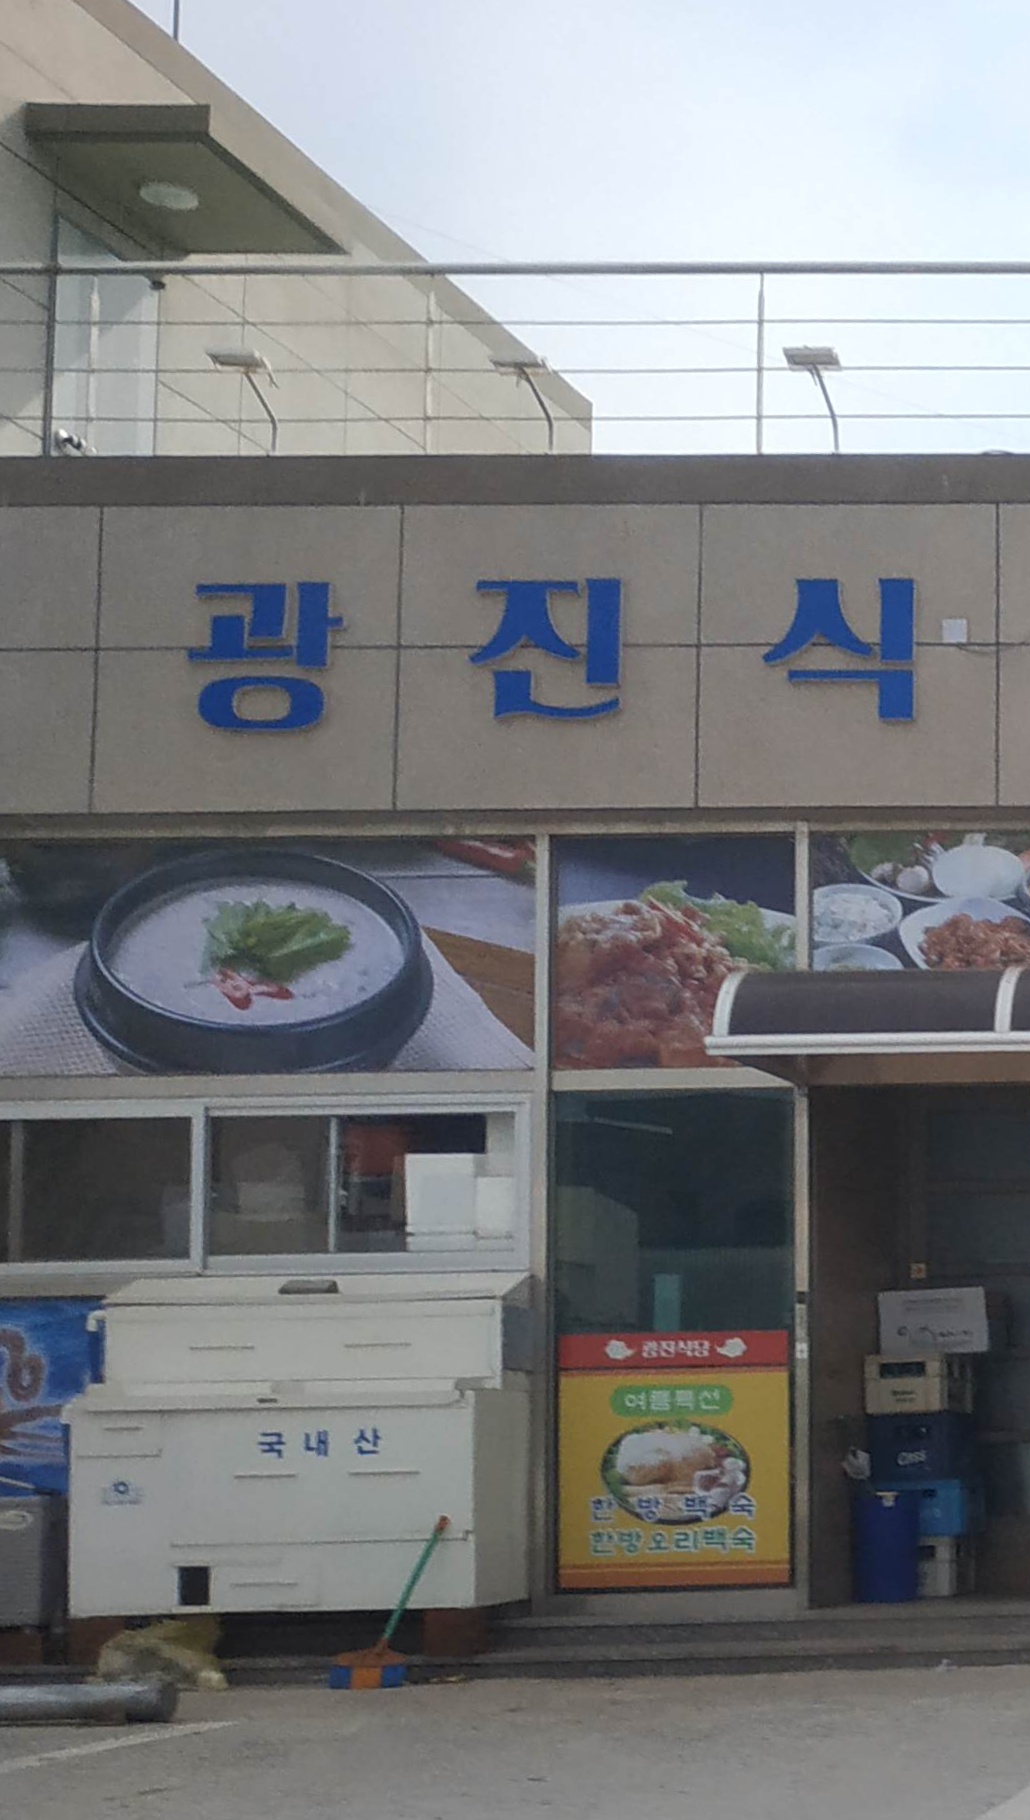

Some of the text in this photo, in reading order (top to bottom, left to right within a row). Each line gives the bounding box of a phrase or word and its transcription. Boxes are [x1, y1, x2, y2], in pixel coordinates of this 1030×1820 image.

[258, 1426, 382, 1458] 국내산
[591, 1493, 756, 1522] 한방백숙
[590, 1526, 756, 1556] 한방오리백숙
